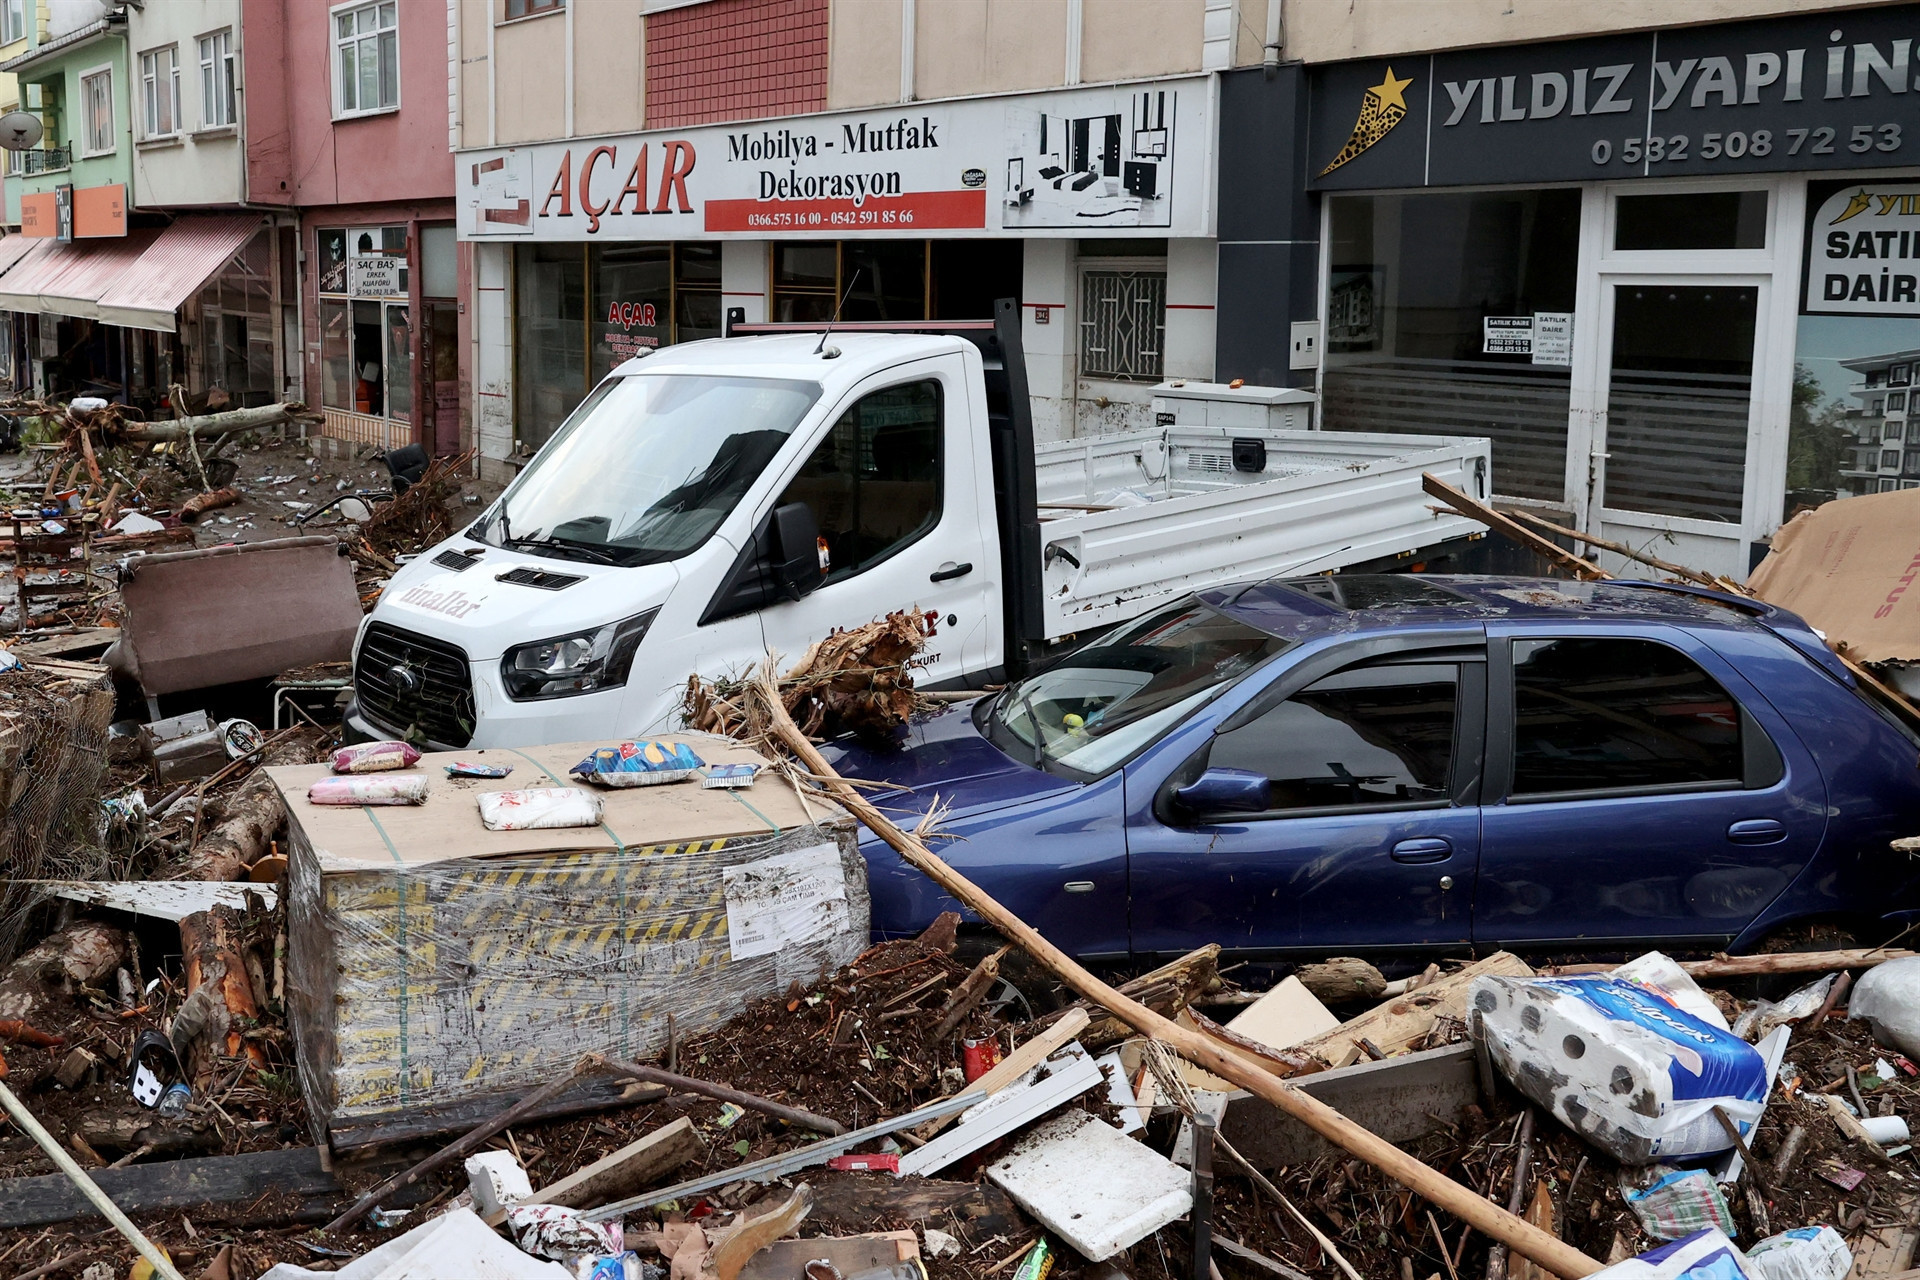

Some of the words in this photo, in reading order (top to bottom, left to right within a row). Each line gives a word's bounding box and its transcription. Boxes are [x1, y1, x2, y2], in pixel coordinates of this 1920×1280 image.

[1443, 63, 1635, 126] YILDIZ
[1651, 48, 1807, 111] YAPI
[1823, 28, 1920, 100] İN
[727, 130, 817, 165] Mobilya
[841, 117, 939, 154] Mutfak
[1591, 139, 1612, 165] 0
[1621, 135, 1690, 163] 532
[1700, 129, 1773, 159] 508
[1786, 126, 1836, 155] 72
[1848, 123, 1902, 153] 53
[538, 140, 697, 234] AÇAR
[759, 169, 902, 204] Dekorasyon
[748, 213, 792, 226] 0366.575
[794, 212, 806, 225] 16
[808, 212, 821, 224] 00
[831, 212, 856, 224] 0542
[859, 211, 878, 223] 591
[882, 210, 896, 223] 85
[899, 210, 913, 222] 66
[357, 260, 374, 271] SAÇ
[376, 260, 395, 271] BAŞ
[1824, 267, 1920, 302] DAİR
[608, 301, 656, 331] AÇAR
[612, 343, 639, 354] DEKORAS
[904, 653, 942, 671] OZKURT
